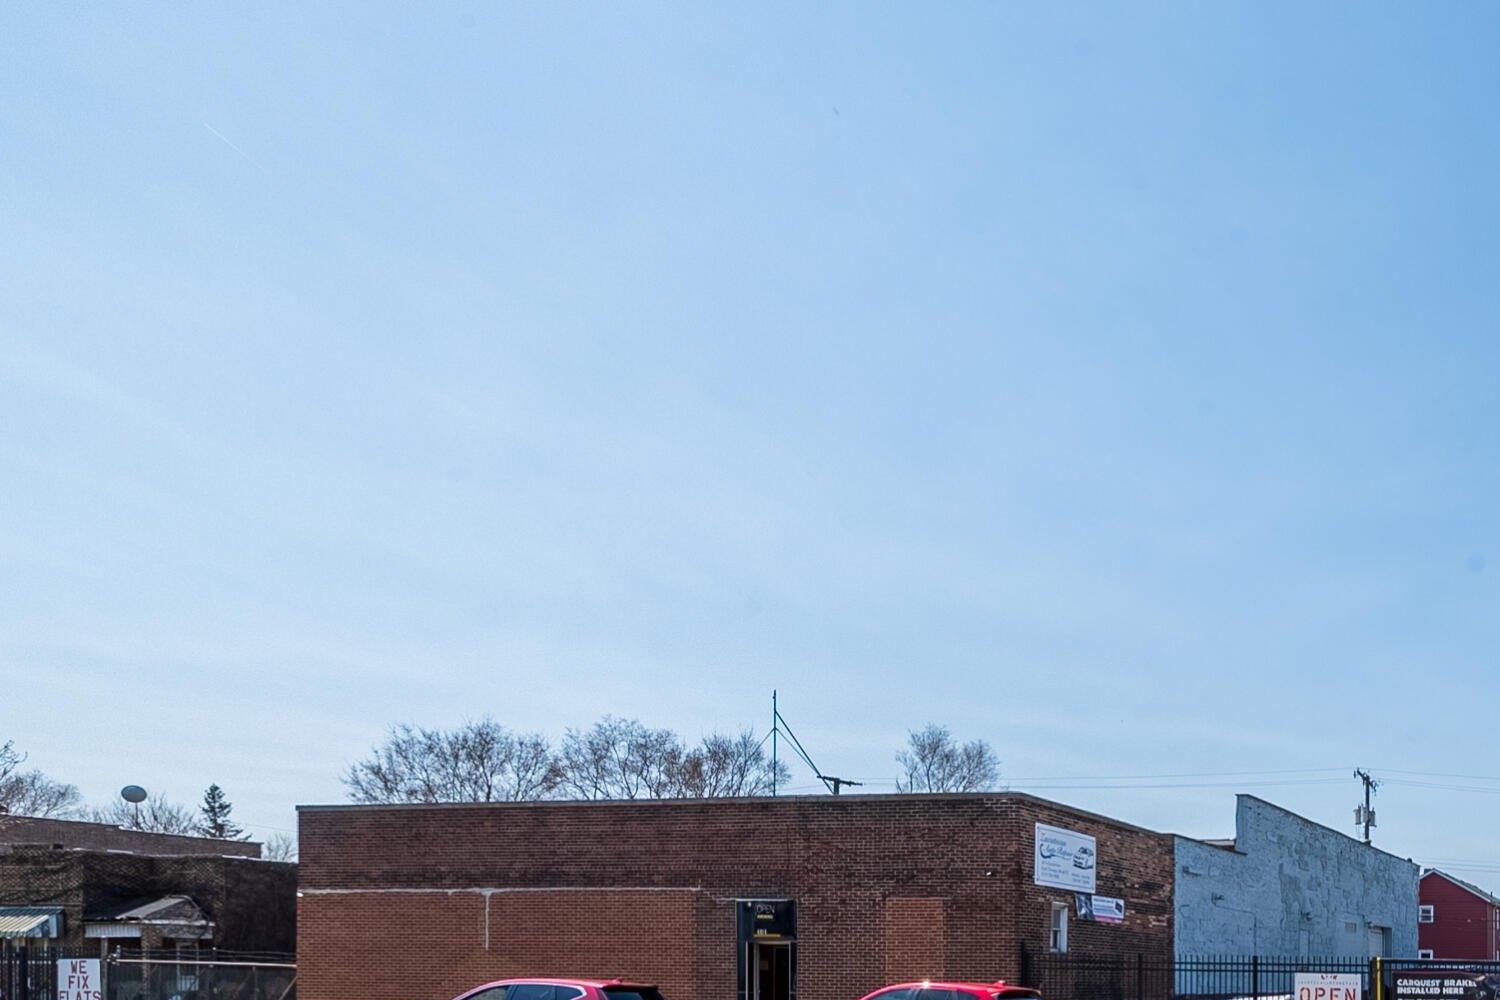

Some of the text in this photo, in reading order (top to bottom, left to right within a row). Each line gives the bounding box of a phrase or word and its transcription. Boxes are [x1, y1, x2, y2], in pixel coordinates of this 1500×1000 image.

[70, 960, 87, 974] WE
[68, 975, 89, 989] FIX
[1396, 979, 1441, 987] CARQUEST
[1396, 986, 1465, 995] INSTALLED HERE
